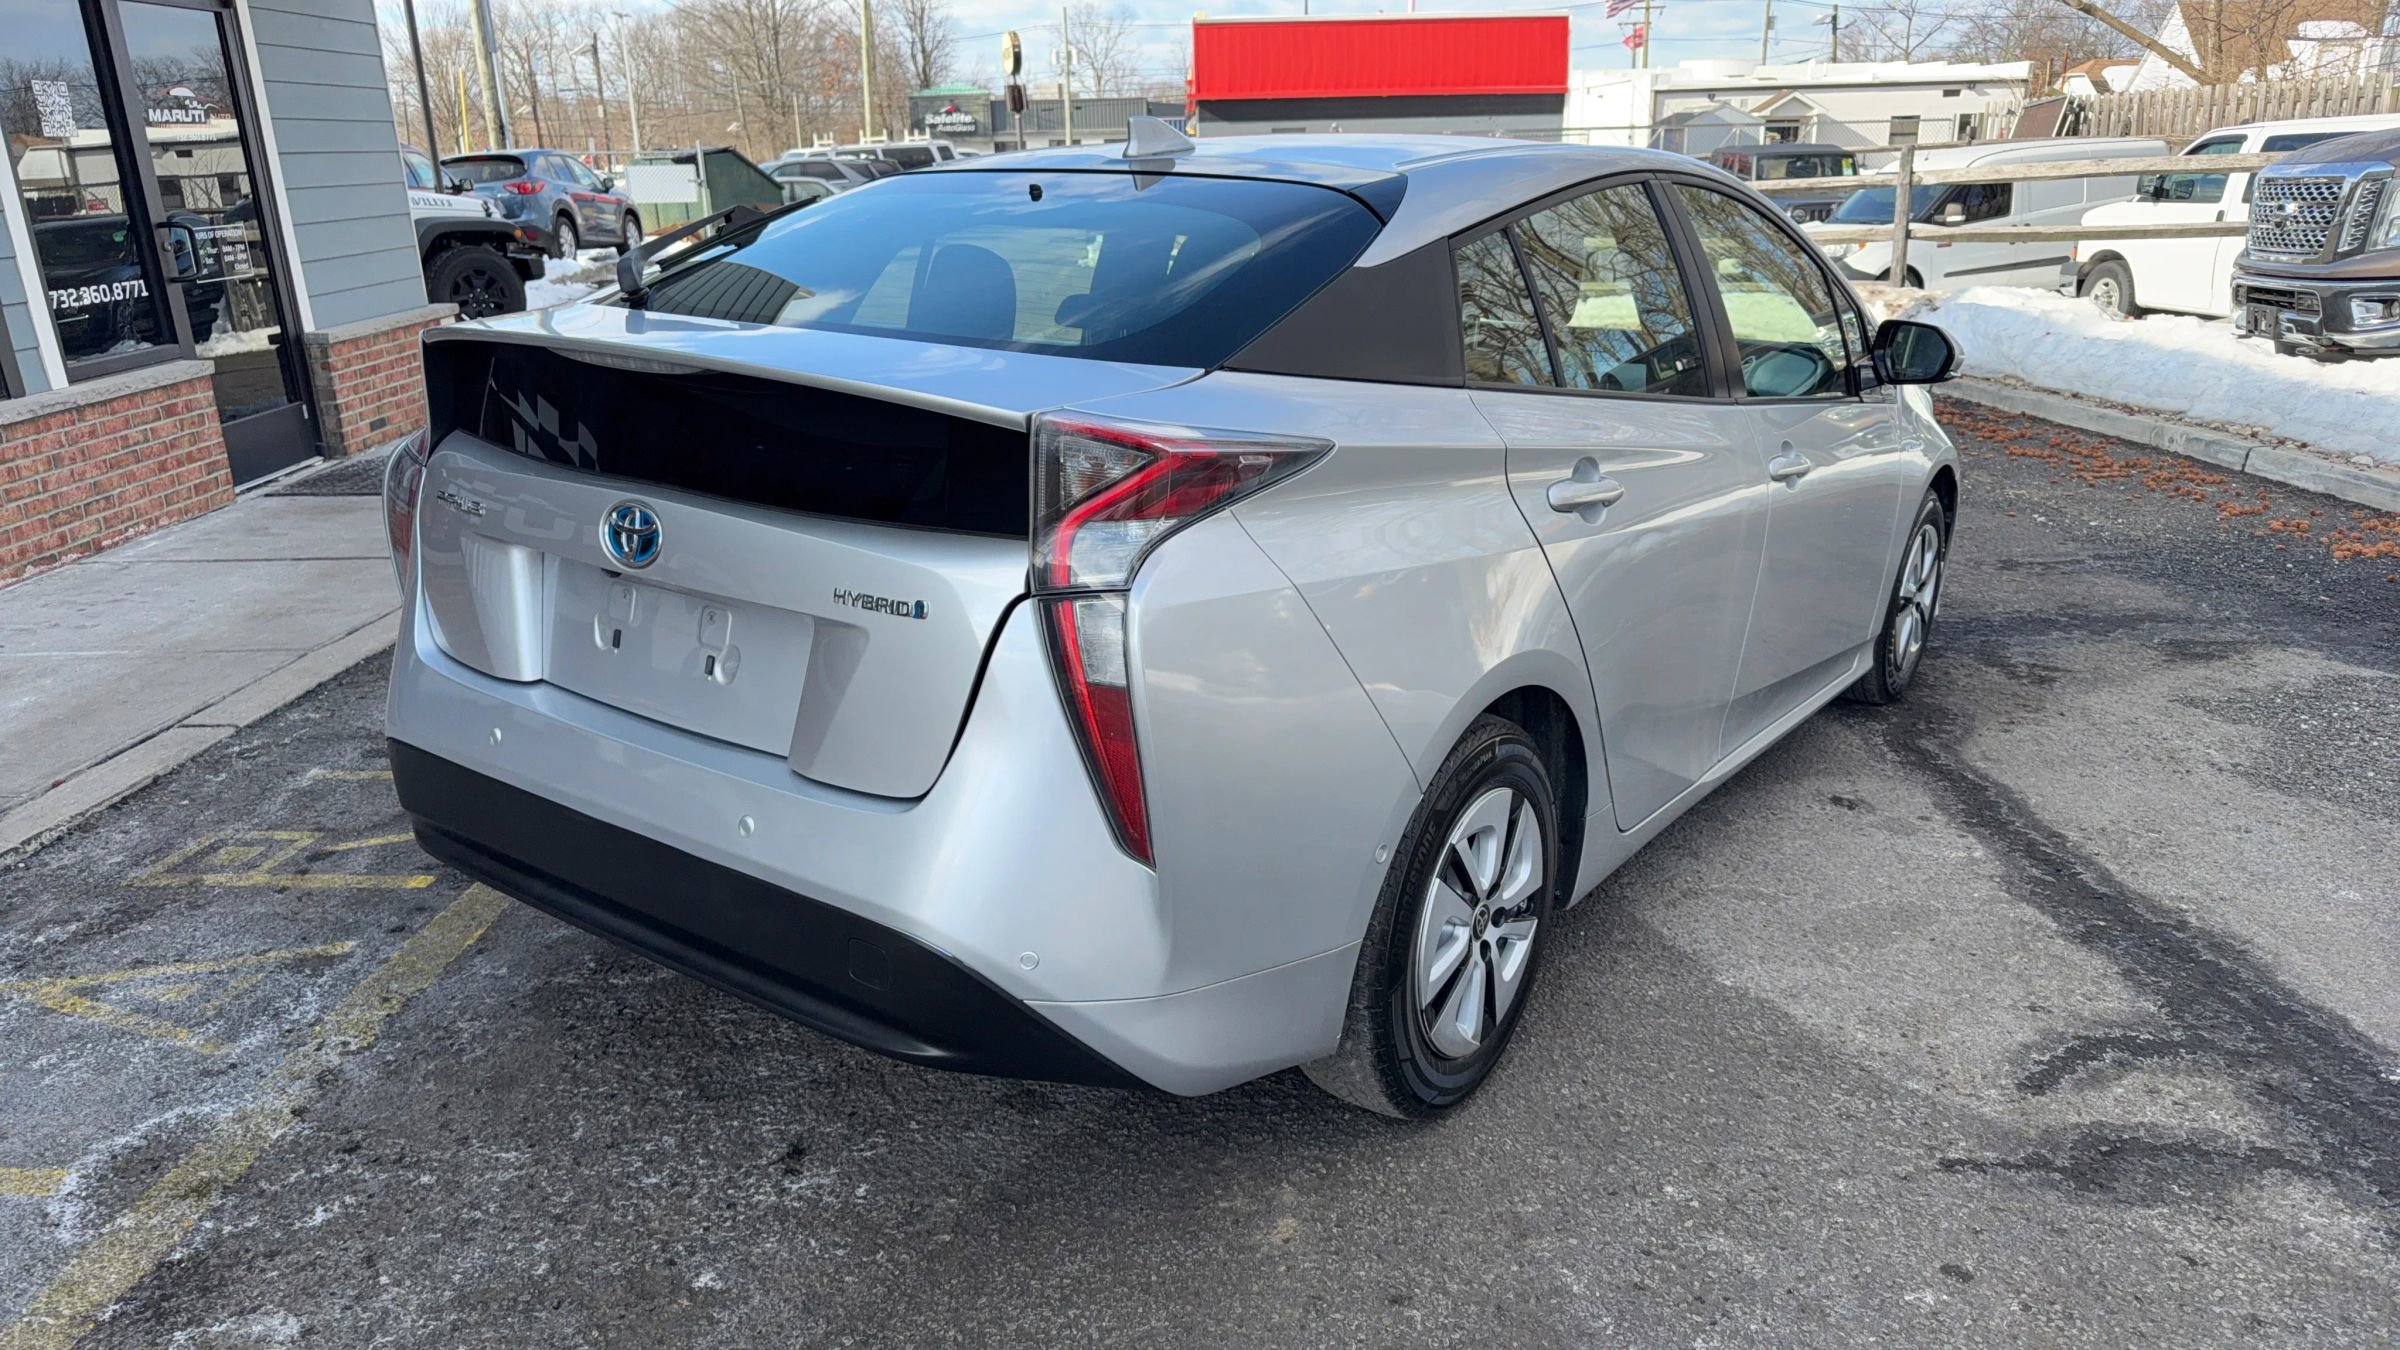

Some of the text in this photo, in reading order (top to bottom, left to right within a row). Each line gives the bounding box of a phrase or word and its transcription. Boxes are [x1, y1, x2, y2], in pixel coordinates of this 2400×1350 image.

[147, 108, 206, 122] MARUTI
[48, 279, 149, 309] 732.360.8771
[833, 587, 912, 618] HYBRID
